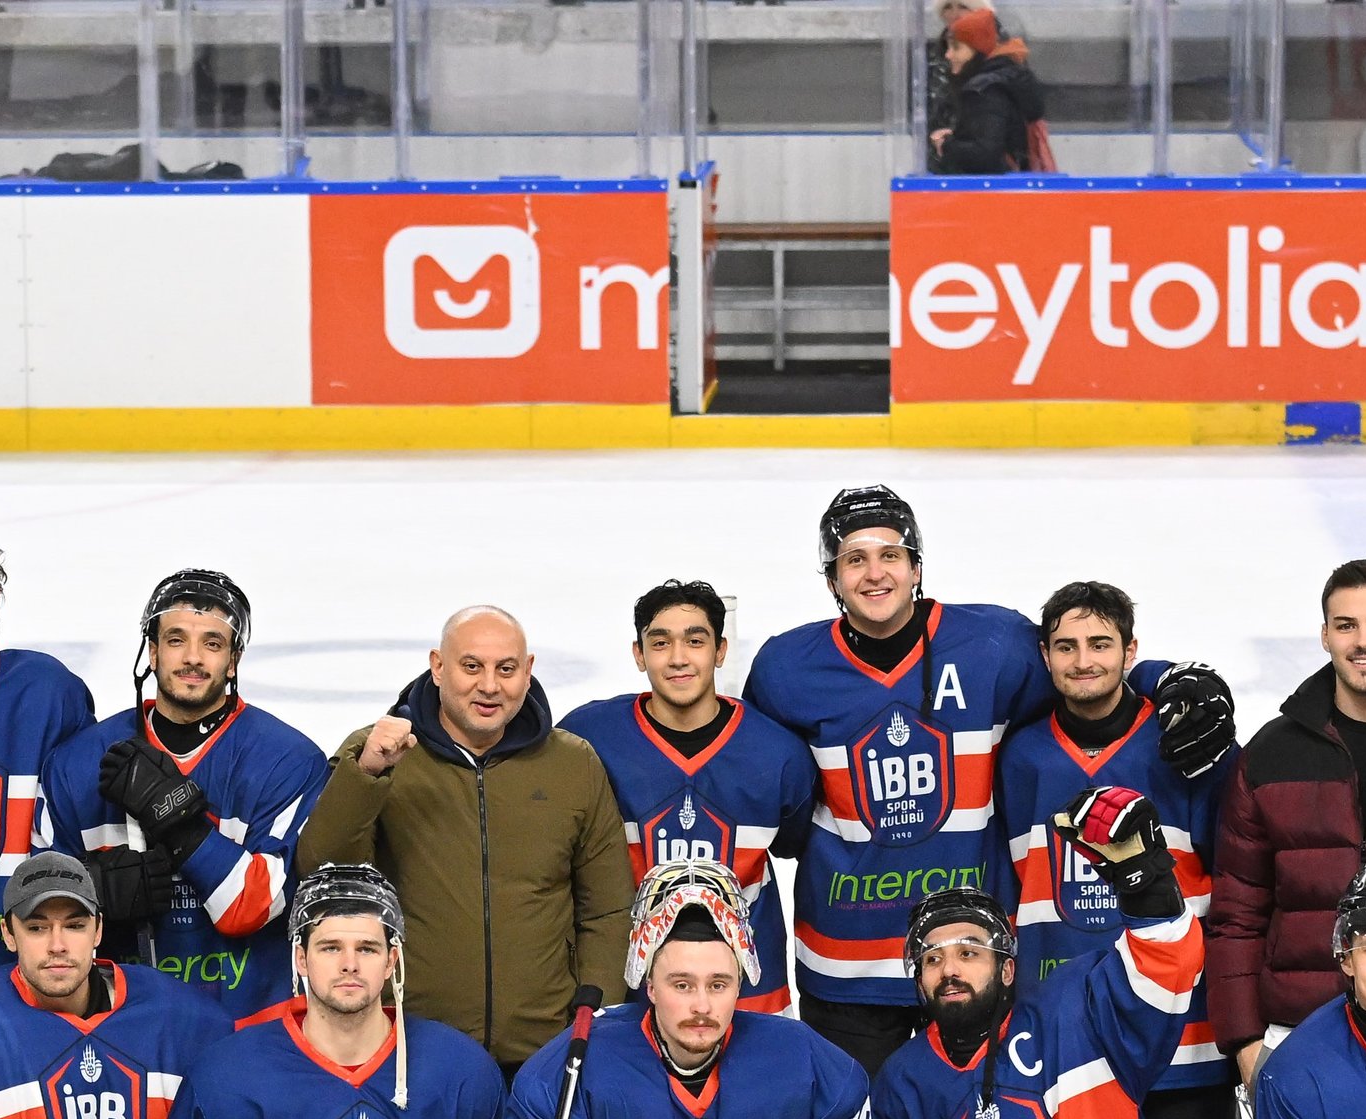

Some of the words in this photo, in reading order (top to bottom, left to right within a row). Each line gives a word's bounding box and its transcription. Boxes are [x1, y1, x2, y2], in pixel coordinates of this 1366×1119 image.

[933, 663, 966, 711] A
[885, 800, 918, 813] SPOR
[22, 869, 85, 888] BAUER
[1080, 884, 1110, 898] SPOR
[1009, 1031, 1044, 1078] C
